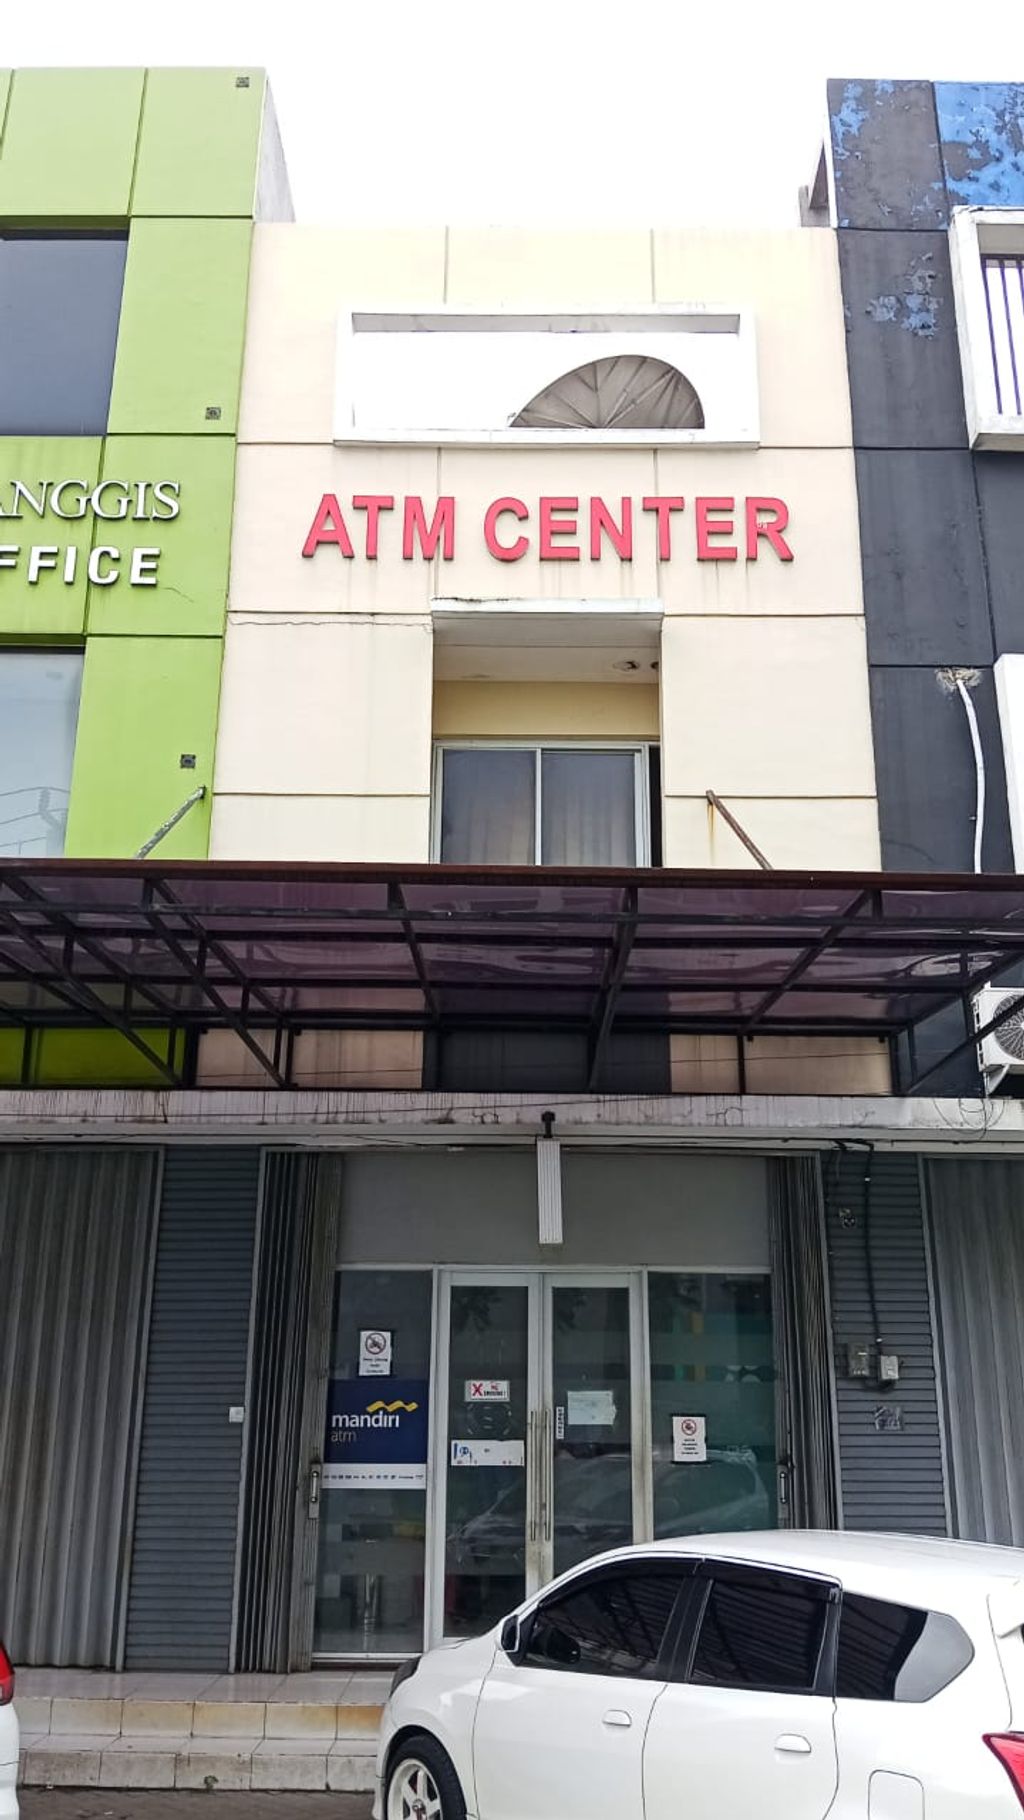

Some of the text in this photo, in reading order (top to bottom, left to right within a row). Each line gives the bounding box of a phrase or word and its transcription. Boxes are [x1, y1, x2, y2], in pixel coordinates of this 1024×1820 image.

[302, 494, 794, 562] ATM CENTER
[331, 1411, 400, 1428] mandiri
[330, 1431, 357, 1442] atm
